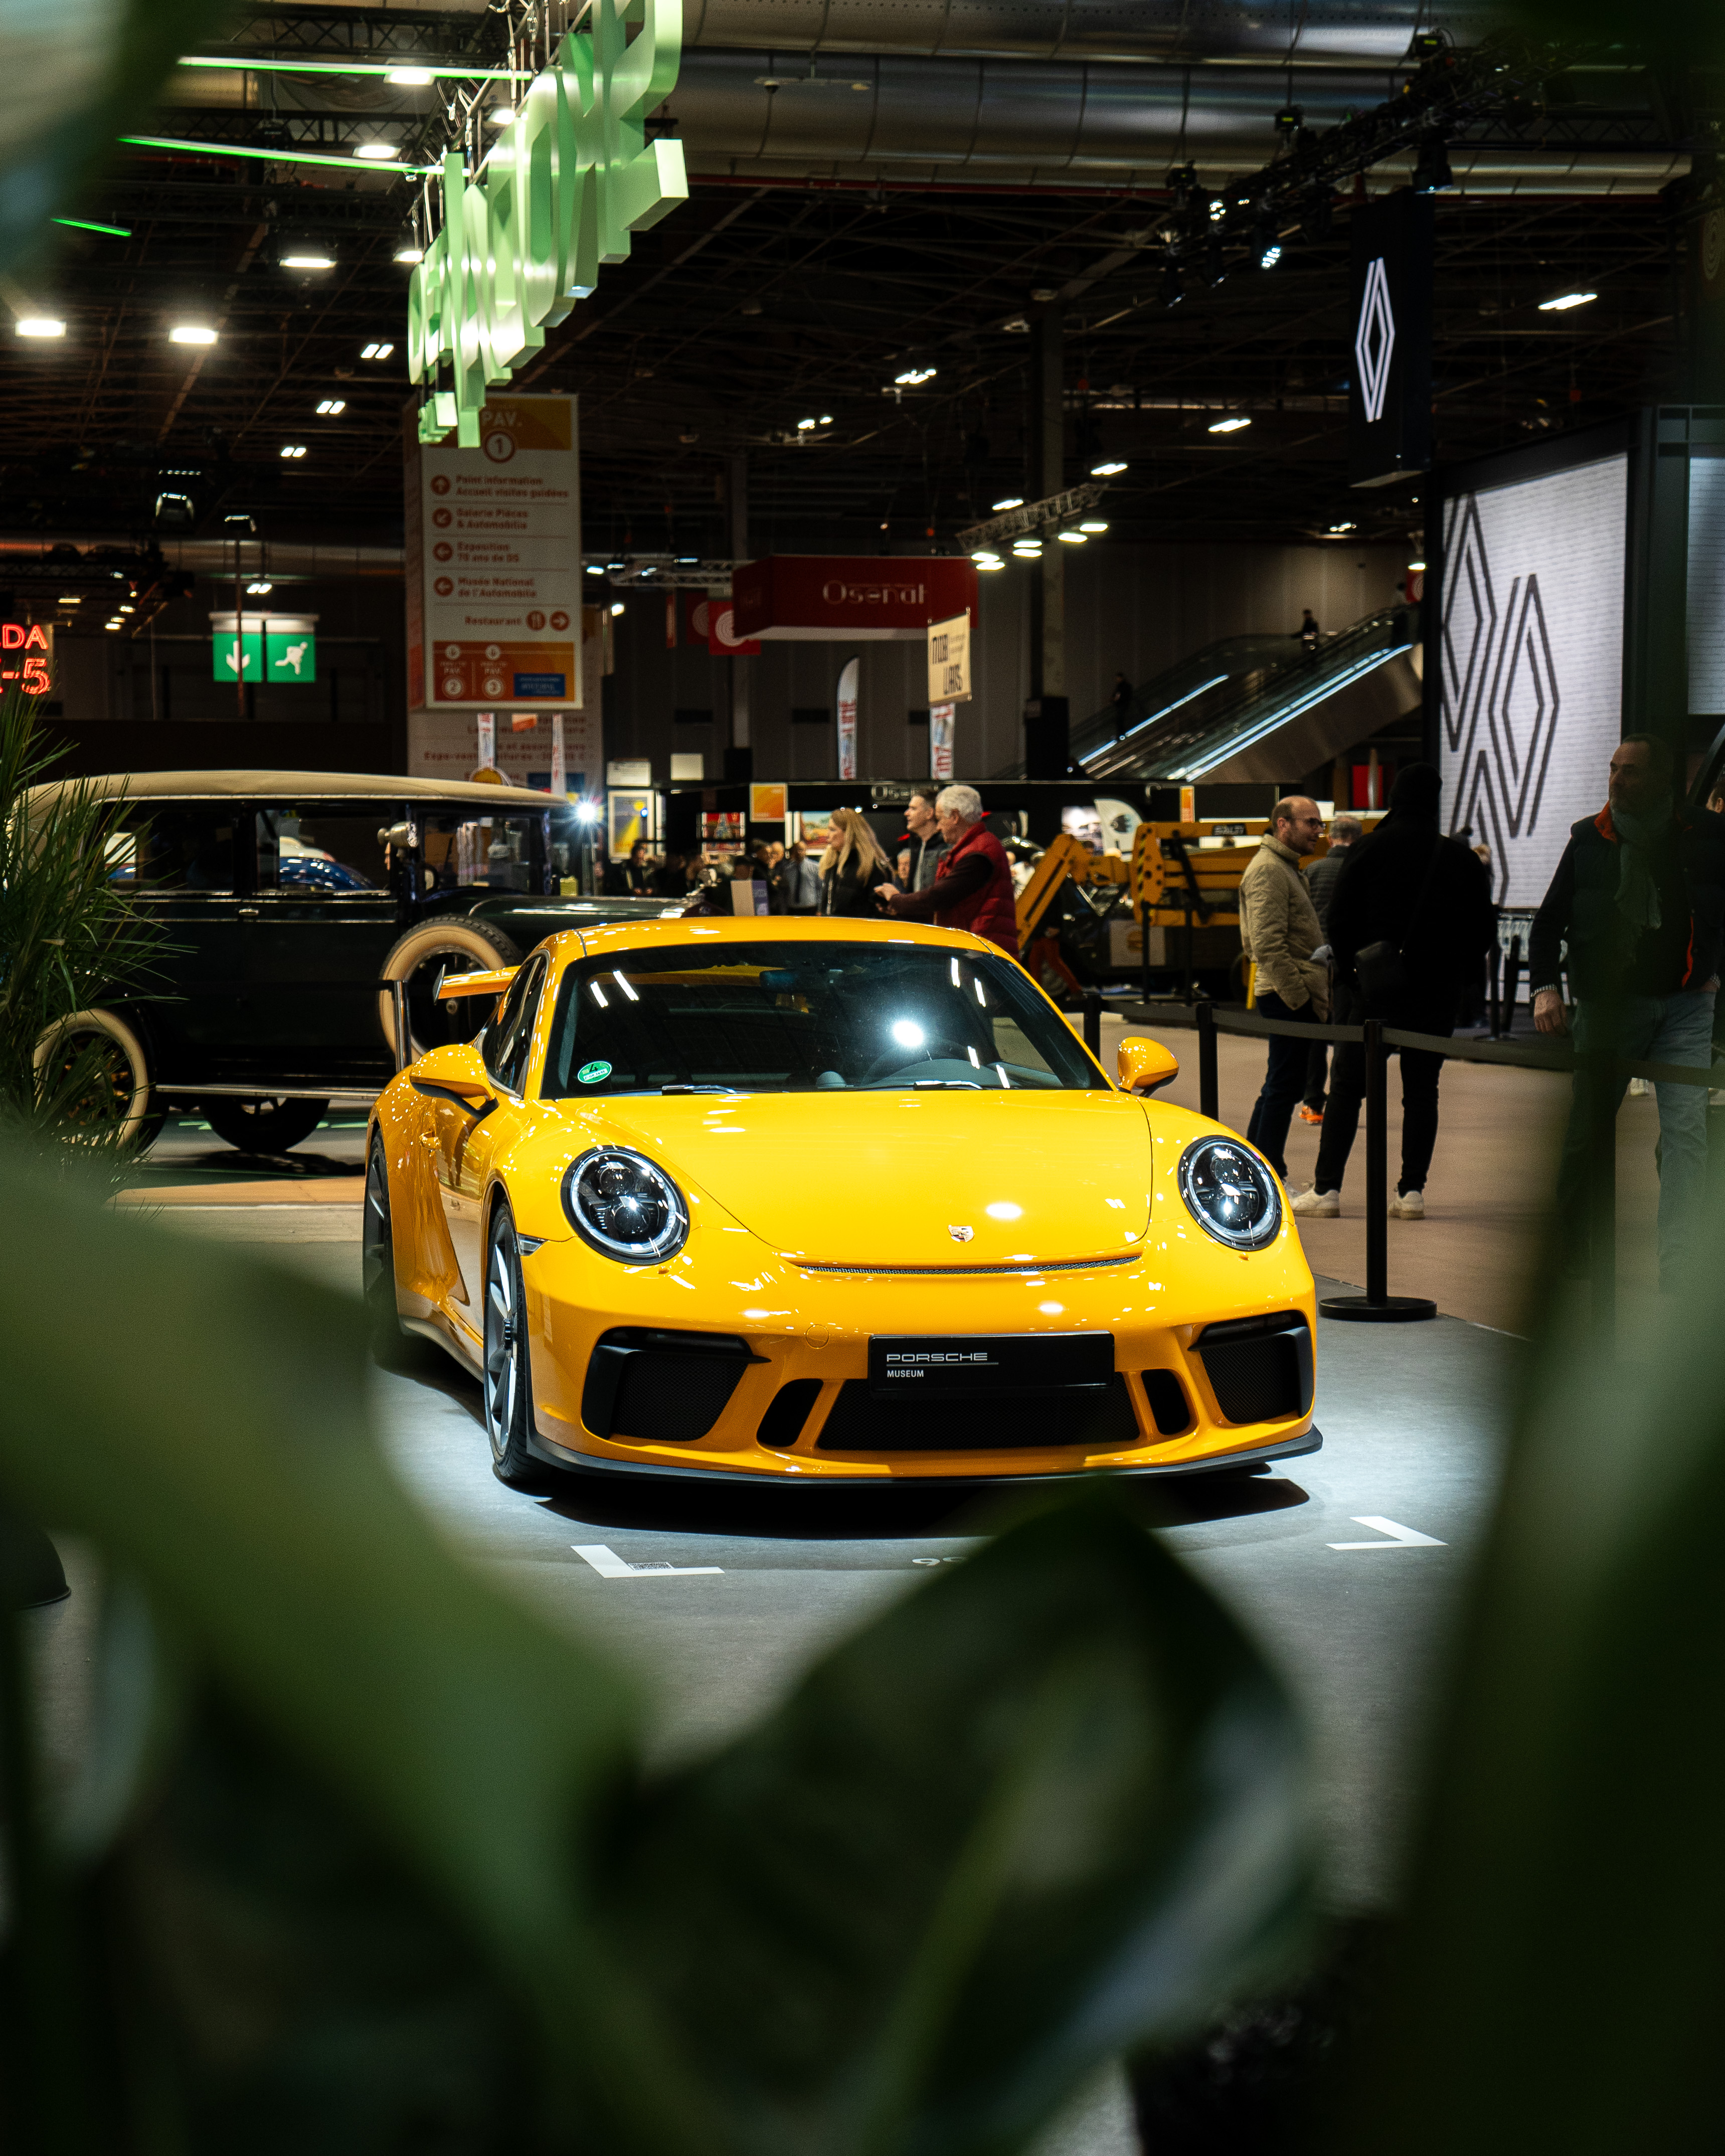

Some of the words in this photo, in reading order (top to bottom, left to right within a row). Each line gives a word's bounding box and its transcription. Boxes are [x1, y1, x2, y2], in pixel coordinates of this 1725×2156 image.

[494, 438, 502, 454] 1
[456, 475, 482, 484] Point
[484, 476, 543, 485] information
[456, 487, 492, 496] Accueil
[494, 488, 528, 497] visites
[467, 520, 527, 529] Automobilia
[457, 542, 510, 552] Exposition
[491, 554, 504, 562] de
[492, 578, 534, 586] National
[458, 589, 470, 597] de
[822, 580, 928, 605] Osenat
[465, 616, 522, 626] Restaurant
[589, 1063, 598, 1072] 4
[886, 1352, 988, 1362] PORSCHE
[887, 1369, 924, 1378] MUSEUM
